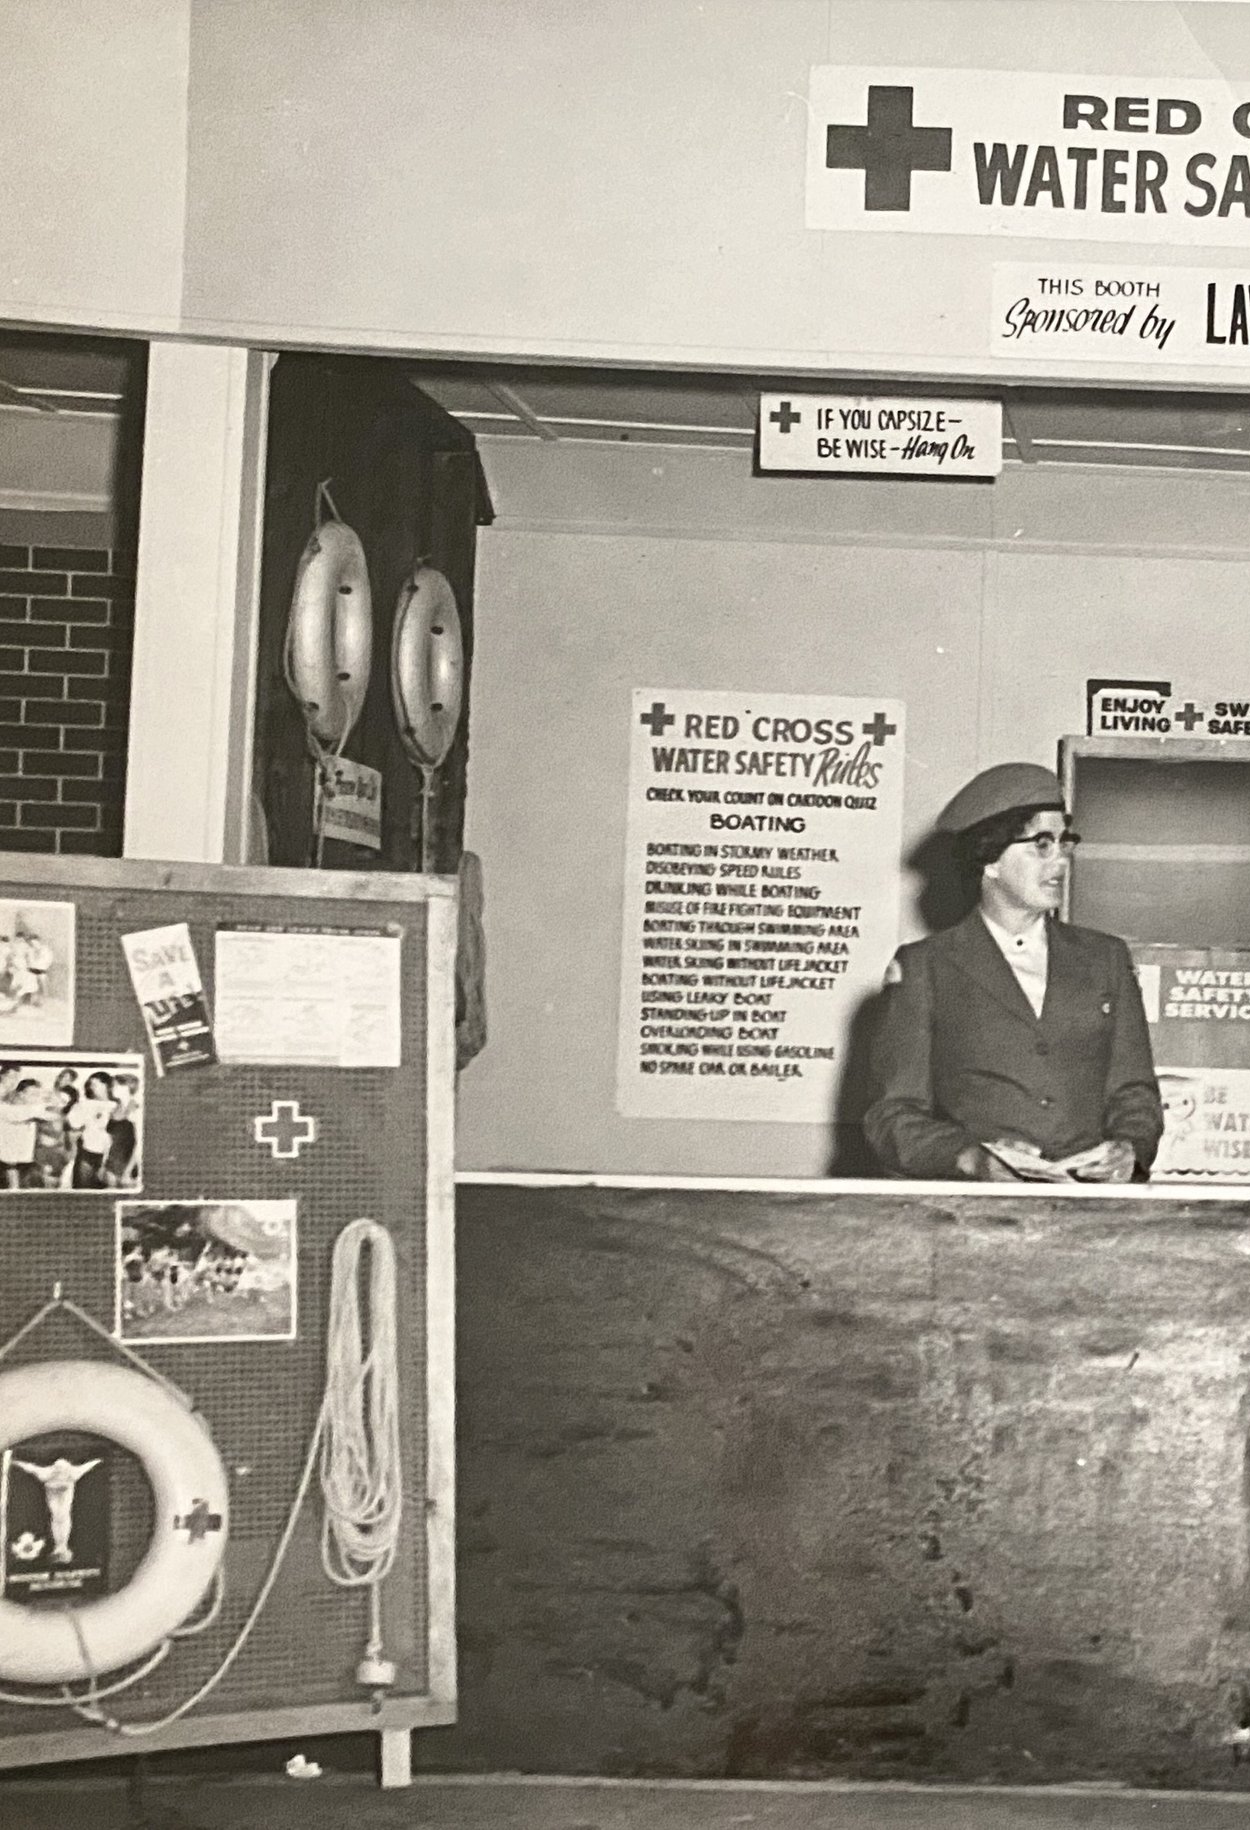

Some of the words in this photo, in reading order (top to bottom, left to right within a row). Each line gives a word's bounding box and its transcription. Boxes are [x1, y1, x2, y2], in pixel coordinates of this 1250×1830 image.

[1062, 94, 1203, 136] RED
[973, 142, 1168, 215] WATER
[1038, 278, 1084, 296] THIS
[1095, 279, 1160, 298] BOOTH
[1002, 298, 1129, 338] Sponsored
[1140, 304, 1176, 350] by
[817, 408, 835, 430] IF
[838, 409, 871, 431] YOU
[817, 438, 841, 458] BE
[950, 433, 974, 460] On
[1101, 697, 1166, 714] ENJOY
[684, 714, 740, 740] RED
[752, 716, 854, 746] CROSS
[1101, 715, 1171, 733] LIVING
[651, 747, 731, 774] WATER
[735, 749, 816, 778] SAFETY
[812, 740, 883, 789] Rules
[646, 787, 685, 802] CHECK
[688, 790, 721, 803] YOUR
[723, 791, 765, 805] COUNT
[767, 792, 784, 806] ON
[787, 793, 842, 808] CARTOON
[844, 795, 877, 810] QUIZ
[710, 813, 806, 833] BOATING
[646, 843, 701, 857] BOATING
[703, 844, 719, 857] IN
[720, 845, 774, 859] STORMY
[777, 847, 839, 862] WEATHER
[645, 861, 716, 877] DISOBEYING
[719, 863, 759, 878] SPEED
[761, 866, 802, 880] RULES
[645, 880, 712, 896] DRINKING
[716, 883, 756, 898] WHILE
[761, 884, 821, 900] BOATING
[686, 902, 700, 915] OF
[787, 904, 862, 920] EQUIPMENT
[643, 919, 696, 933] BOATING
[700, 920, 755, 934] THROUGH
[758, 922, 826, 936] SWIMMING
[828, 925, 860, 938] AREA
[642, 937, 682, 950] WATER
[728, 940, 742, 951] IN
[745, 940, 814, 954] SWIMMING
[816, 942, 849, 955] AREA
[642, 955, 682, 969] WATER
[727, 957, 776, 971] WITHOUT
[642, 973, 699, 987] BOATING
[702, 975, 757, 988] WITHOUT
[641, 990, 683, 1003] USING
[687, 991, 729, 1005] LEAKY
[733, 992, 772, 1006] BOAT
[640, 1007, 707, 1021] STANDING
[710, 1009, 731, 1021] UP
[733, 1010, 748, 1021] IN
[751, 1010, 787, 1022] BOAT
[640, 1025, 733, 1040] OVERLOADING
[738, 1027, 780, 1041] BOAT
[774, 1045, 834, 1060] GASOLINE
[640, 1060, 657, 1074] NO
